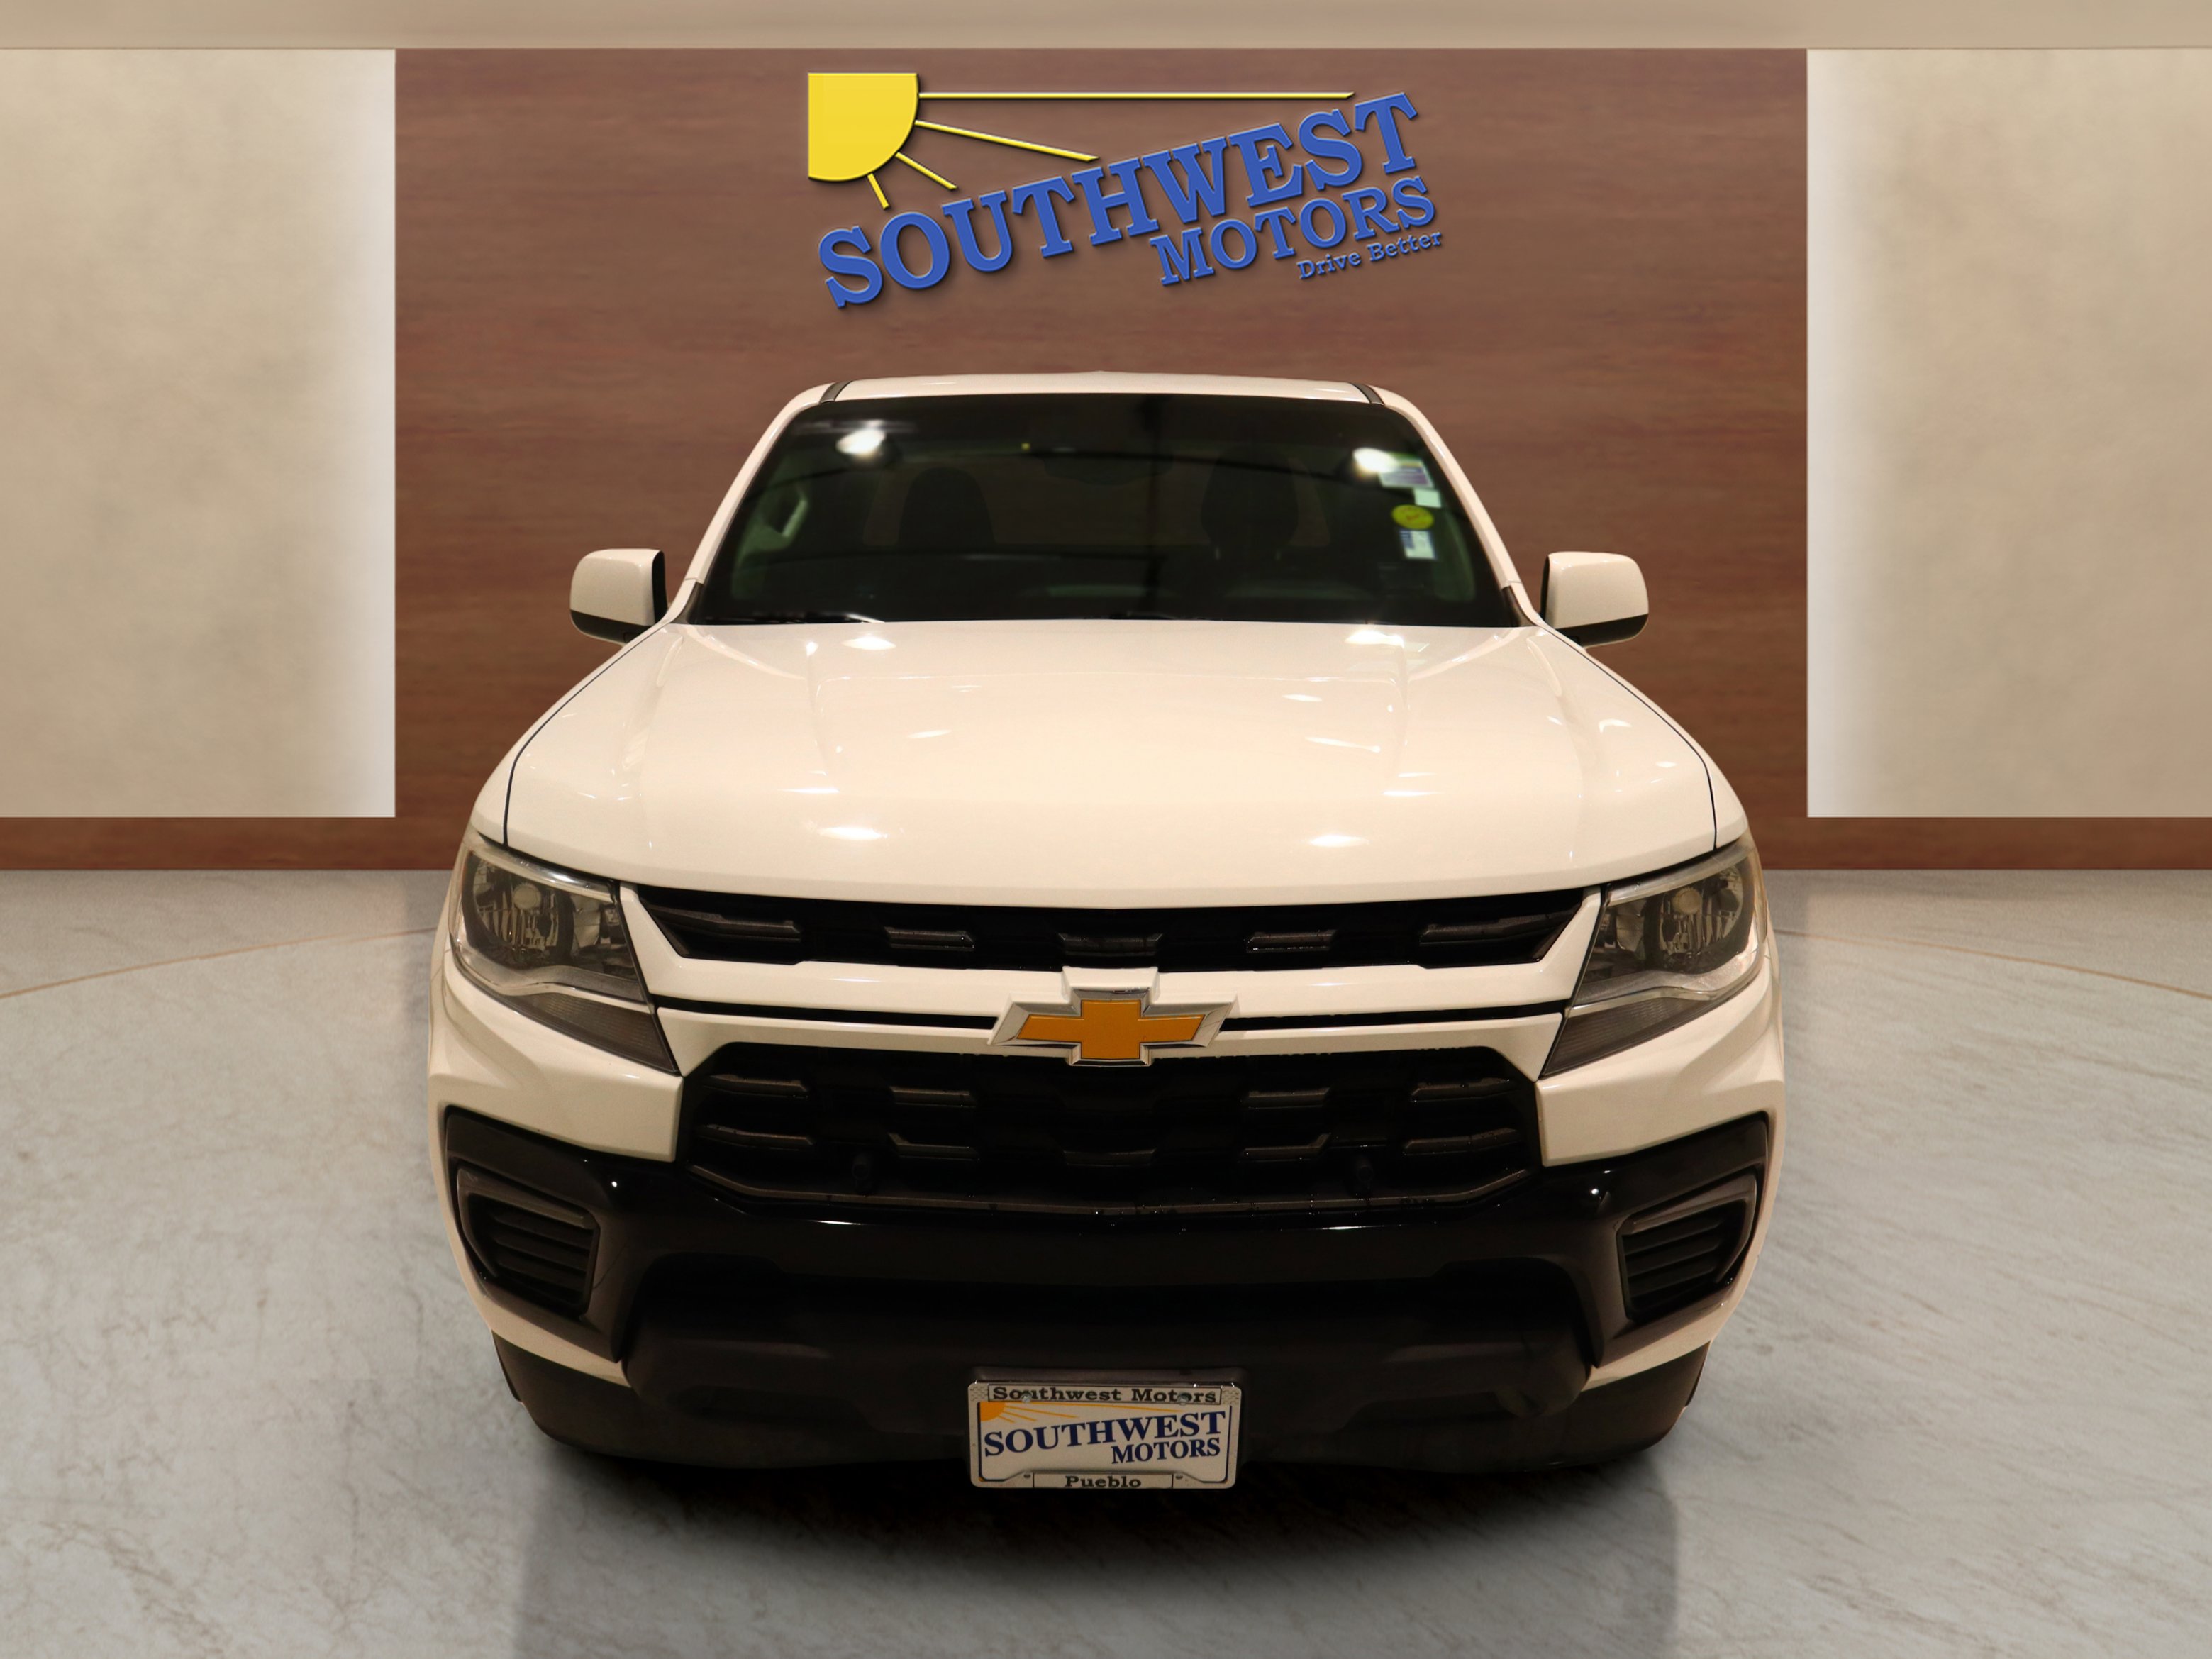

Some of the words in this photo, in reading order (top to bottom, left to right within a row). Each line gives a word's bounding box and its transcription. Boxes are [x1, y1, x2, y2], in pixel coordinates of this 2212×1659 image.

[818, 92, 1418, 308] SOUTHWEST
[1149, 176, 1435, 287] MOTORS
[1296, 251, 1362, 280] Drive
[1367, 232, 1443, 262] Better
[1131, 1388, 1217, 1403] Motors
[984, 1411, 1226, 1458] SOUTHWEST
[1111, 1437, 1221, 1464] MOTORS
[1065, 1475, 1142, 1489] Pueblo
